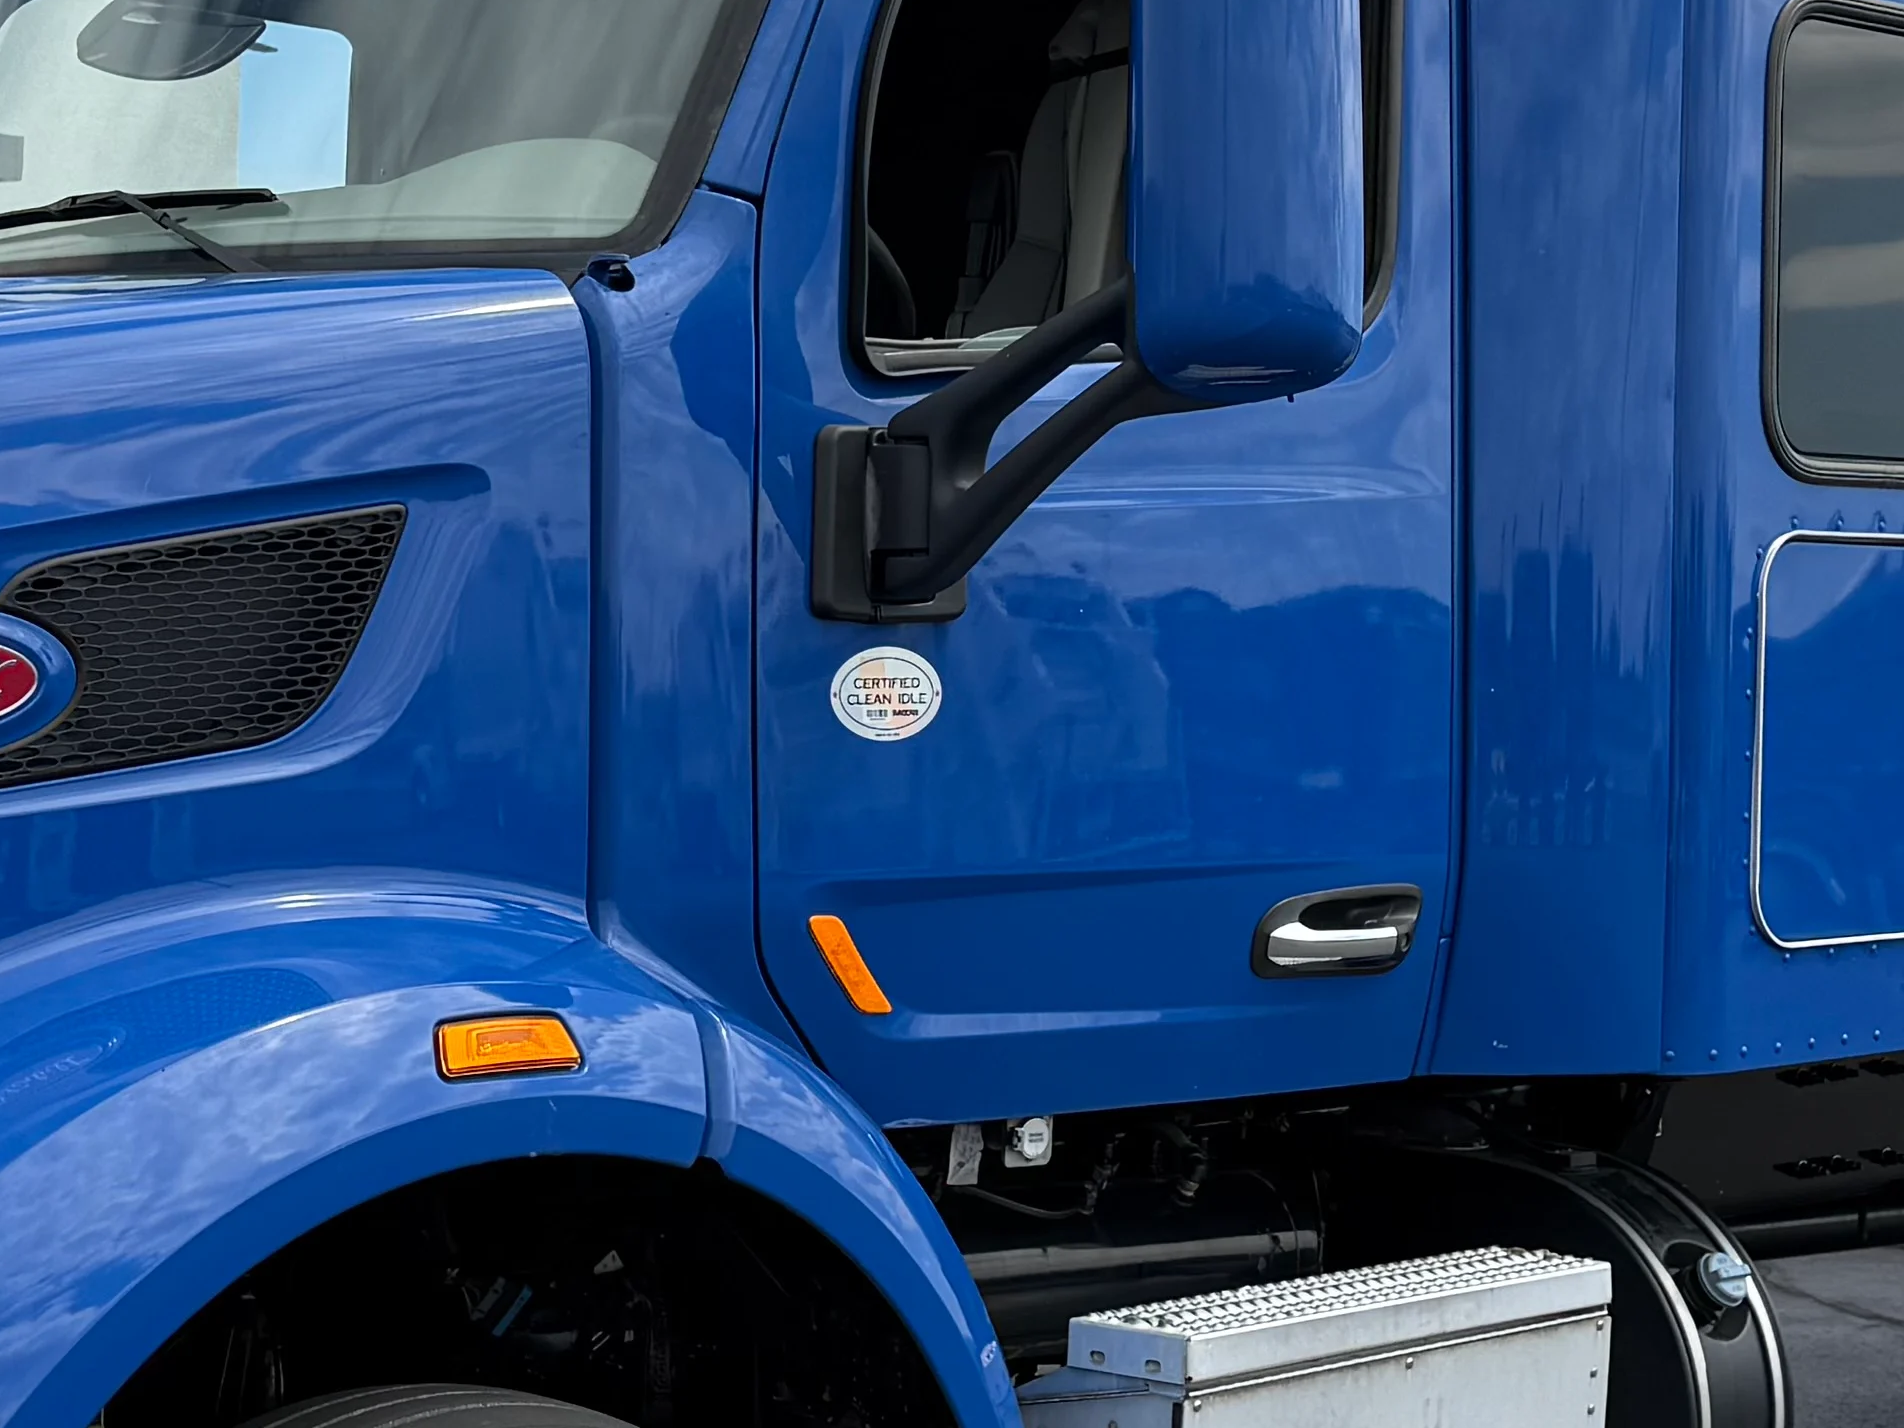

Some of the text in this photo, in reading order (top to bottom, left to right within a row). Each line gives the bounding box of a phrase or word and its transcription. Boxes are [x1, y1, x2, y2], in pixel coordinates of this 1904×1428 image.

[853, 677, 921, 690] CERTIFIED
[847, 693, 928, 706] CLEAN IDLE
